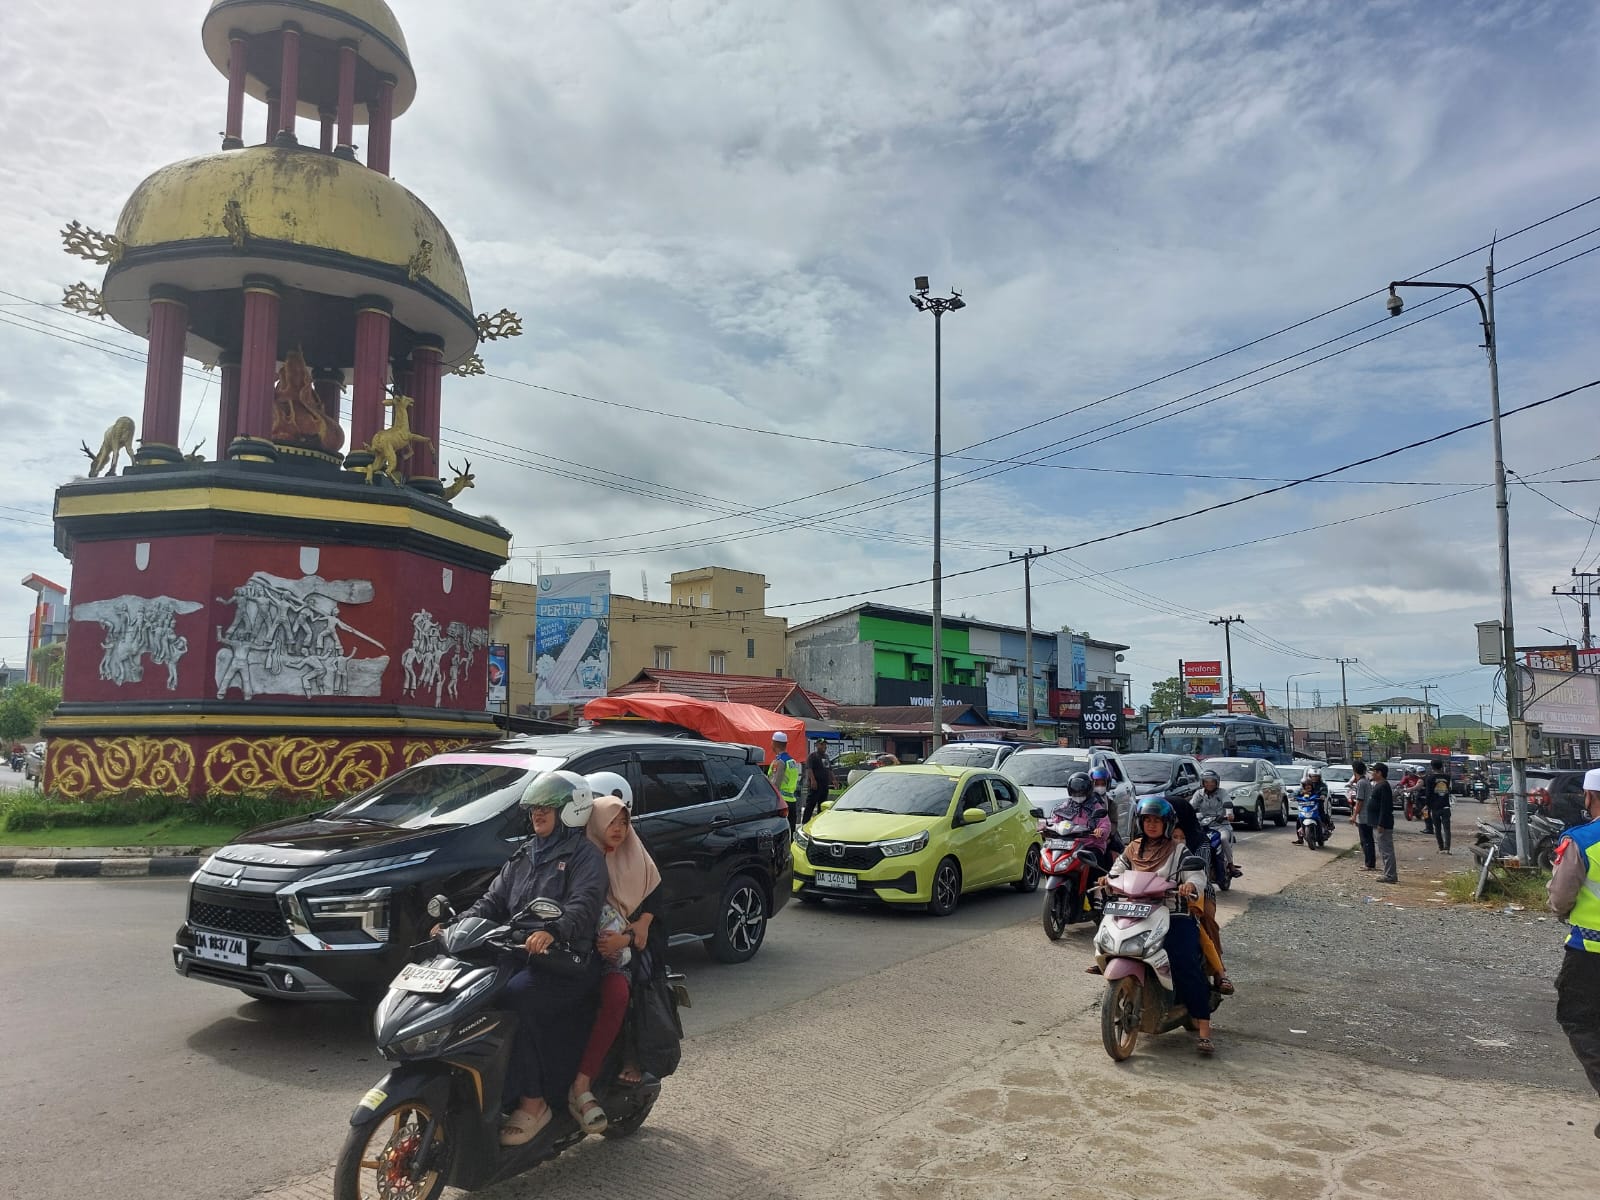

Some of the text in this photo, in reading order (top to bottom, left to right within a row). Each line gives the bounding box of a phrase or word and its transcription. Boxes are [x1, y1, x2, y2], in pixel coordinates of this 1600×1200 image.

[541, 603, 586, 616] PERTIWI
[1187, 665, 1217, 673] erafone
[942, 699, 963, 707] SOLO
[1083, 713, 1117, 722] WONG
[1085, 722, 1115, 730] SOLO
[459, 1016, 487, 1035] HONDA
